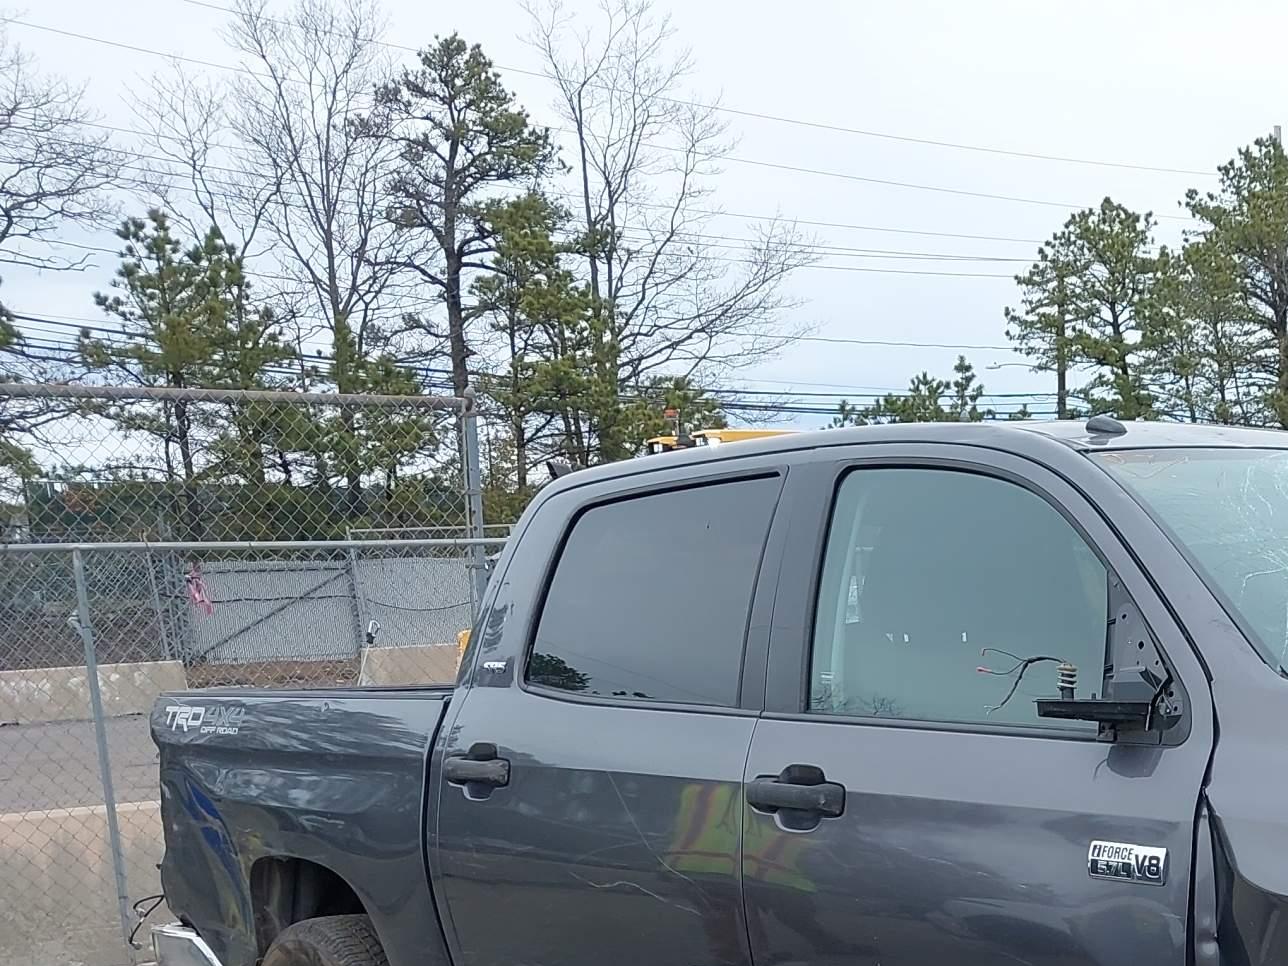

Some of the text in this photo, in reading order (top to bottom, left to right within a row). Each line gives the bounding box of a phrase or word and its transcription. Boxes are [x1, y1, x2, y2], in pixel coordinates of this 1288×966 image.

[166, 706, 205, 732] TRD
[200, 726, 239, 735] OFF ROAD
[1134, 854, 1161, 878] V8
